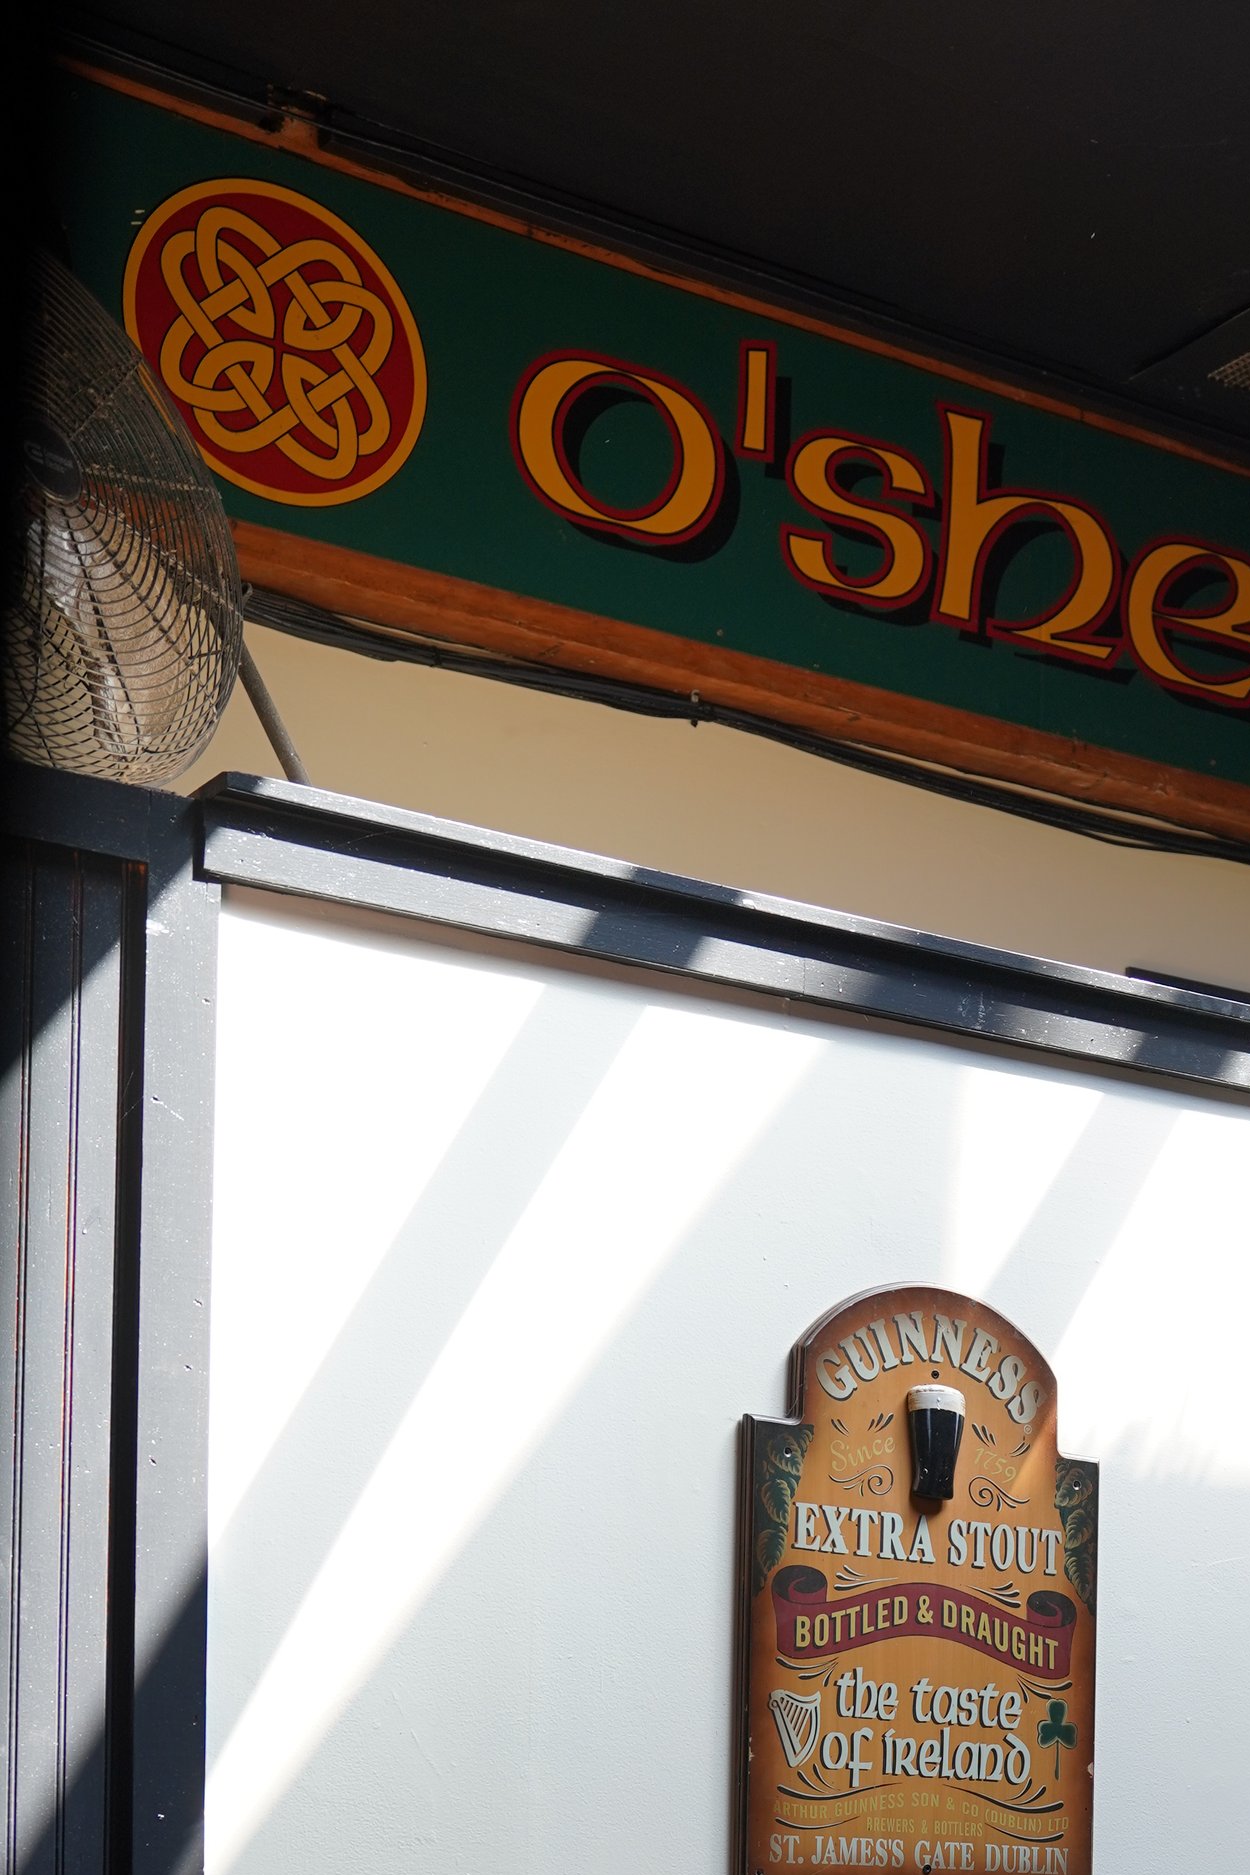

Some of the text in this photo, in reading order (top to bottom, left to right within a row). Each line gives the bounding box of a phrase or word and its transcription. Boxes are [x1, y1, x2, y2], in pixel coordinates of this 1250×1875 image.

[815, 1311, 1048, 1424] GUINNESS
[830, 1437, 1018, 1484] Since 1759
[792, 1501, 1063, 1576] EXTRA STOUT
[795, 1595, 1060, 1671] BOTTLED & DRAUGHT
[834, 1667, 1023, 1730] the taste
[819, 1726, 875, 1788] of
[773, 1791, 1070, 1834] ARTHUR GUINNESS SON & CO (DUBLIN) LTD
[866, 1815, 983, 1839] BREWERS & BOTTLERS
[769, 1833, 1069, 1875] ST. JAMES'S GATE DUBLIN
